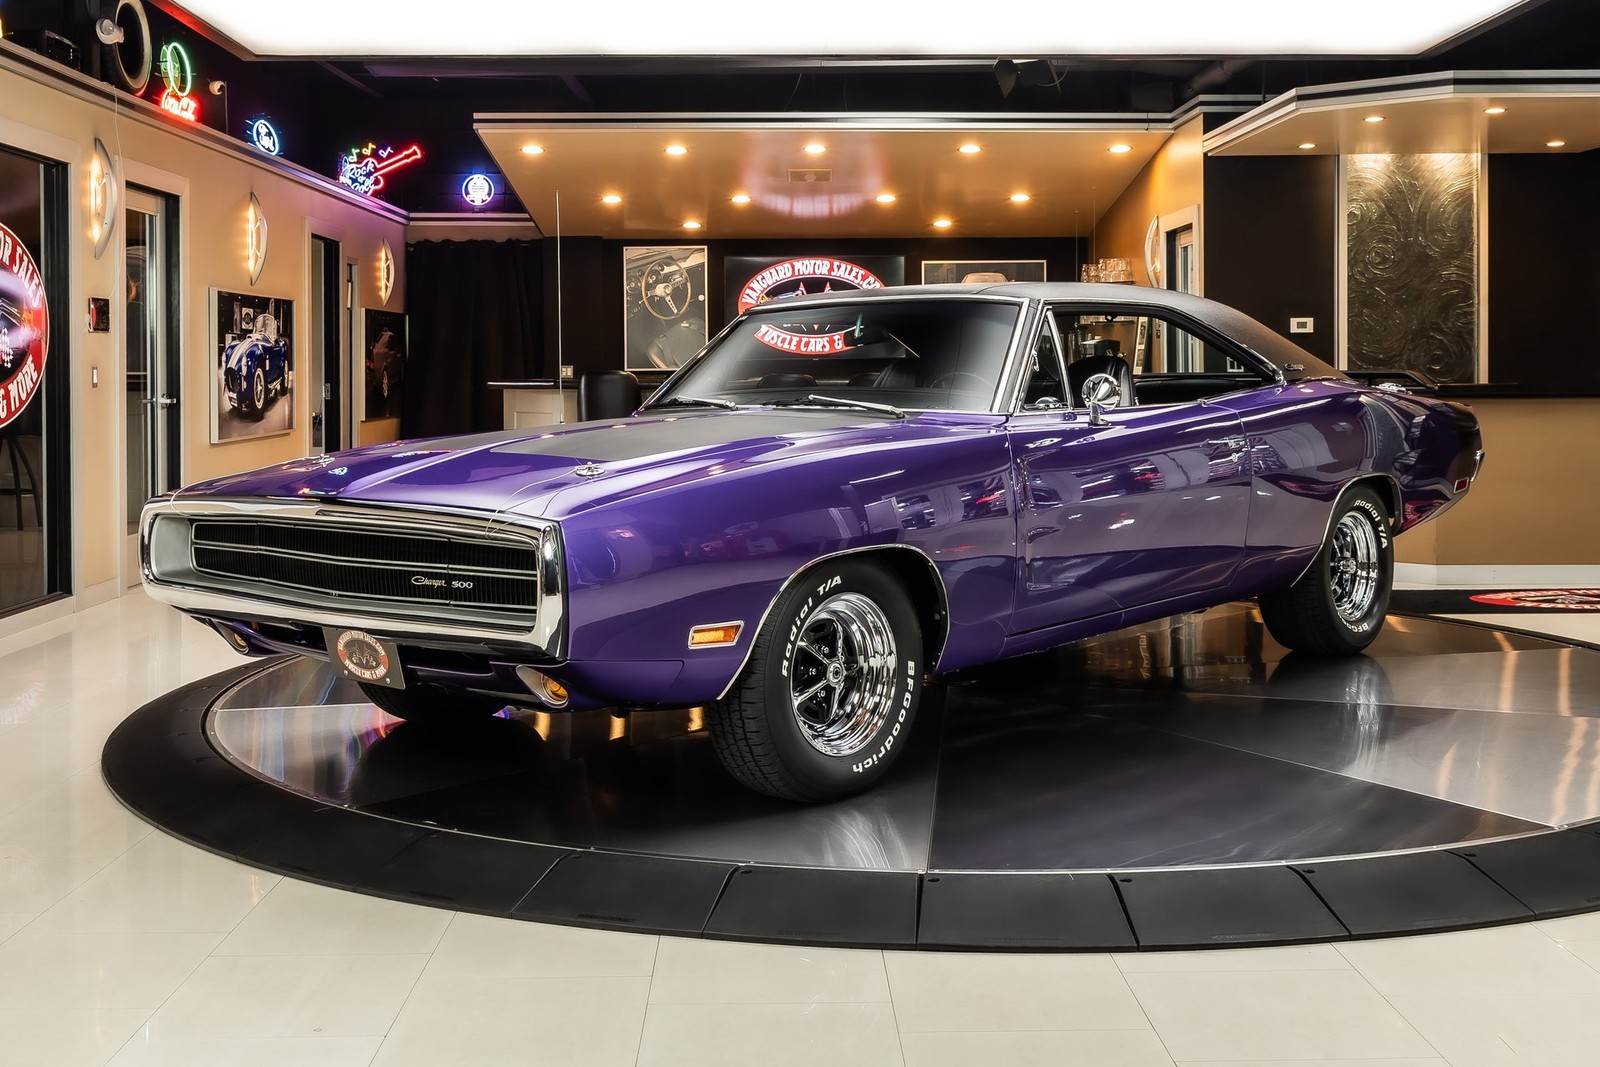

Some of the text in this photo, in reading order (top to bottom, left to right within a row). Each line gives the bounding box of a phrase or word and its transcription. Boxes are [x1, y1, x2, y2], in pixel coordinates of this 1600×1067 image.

[348, 159, 375, 179] Rock
[12, 244, 44, 309] SALES
[741, 259, 881, 305] VANGUARD MOTOR SALES.CO
[800, 337, 831, 352] CARS
[833, 335, 843, 350] &
[7, 354, 39, 413] MORE
[1353, 499, 1388, 549] Radial T/A
[451, 580, 474, 589] 500
[781, 575, 842, 678] Radial T/A
[852, 660, 915, 774] BFGoodrich
